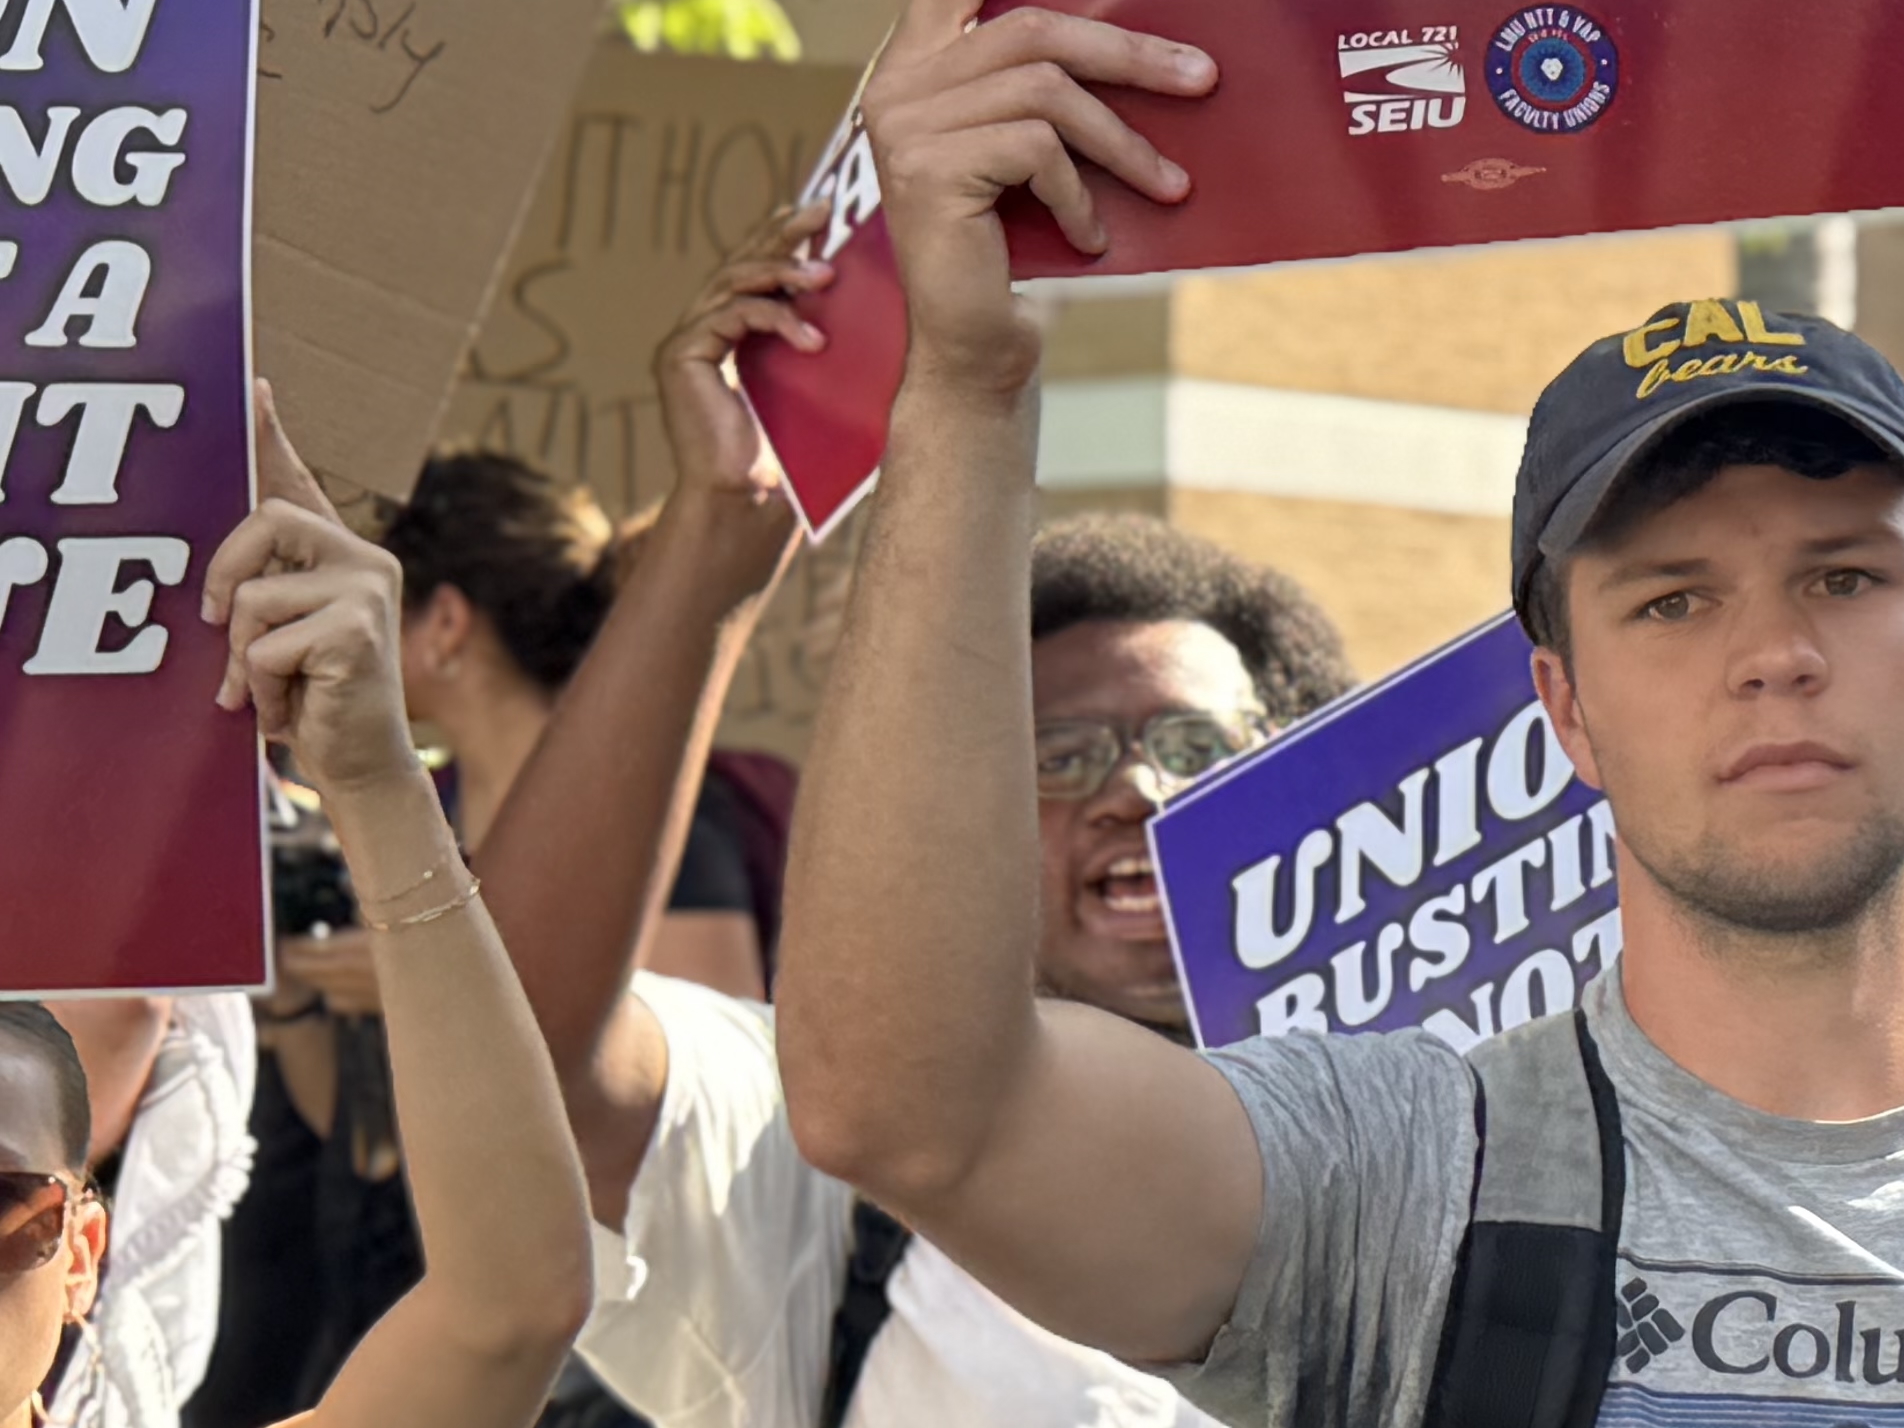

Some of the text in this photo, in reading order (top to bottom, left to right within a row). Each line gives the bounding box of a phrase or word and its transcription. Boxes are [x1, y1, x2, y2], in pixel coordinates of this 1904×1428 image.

[1338, 25, 1457, 50] LOCAL 721
[1348, 96, 1466, 136] SEIU
[1499, 87, 1559, 130] FACULTY
[24, 239, 151, 348] A
[1623, 297, 1806, 368] CAL
[1232, 699, 1575, 970] UNIO
